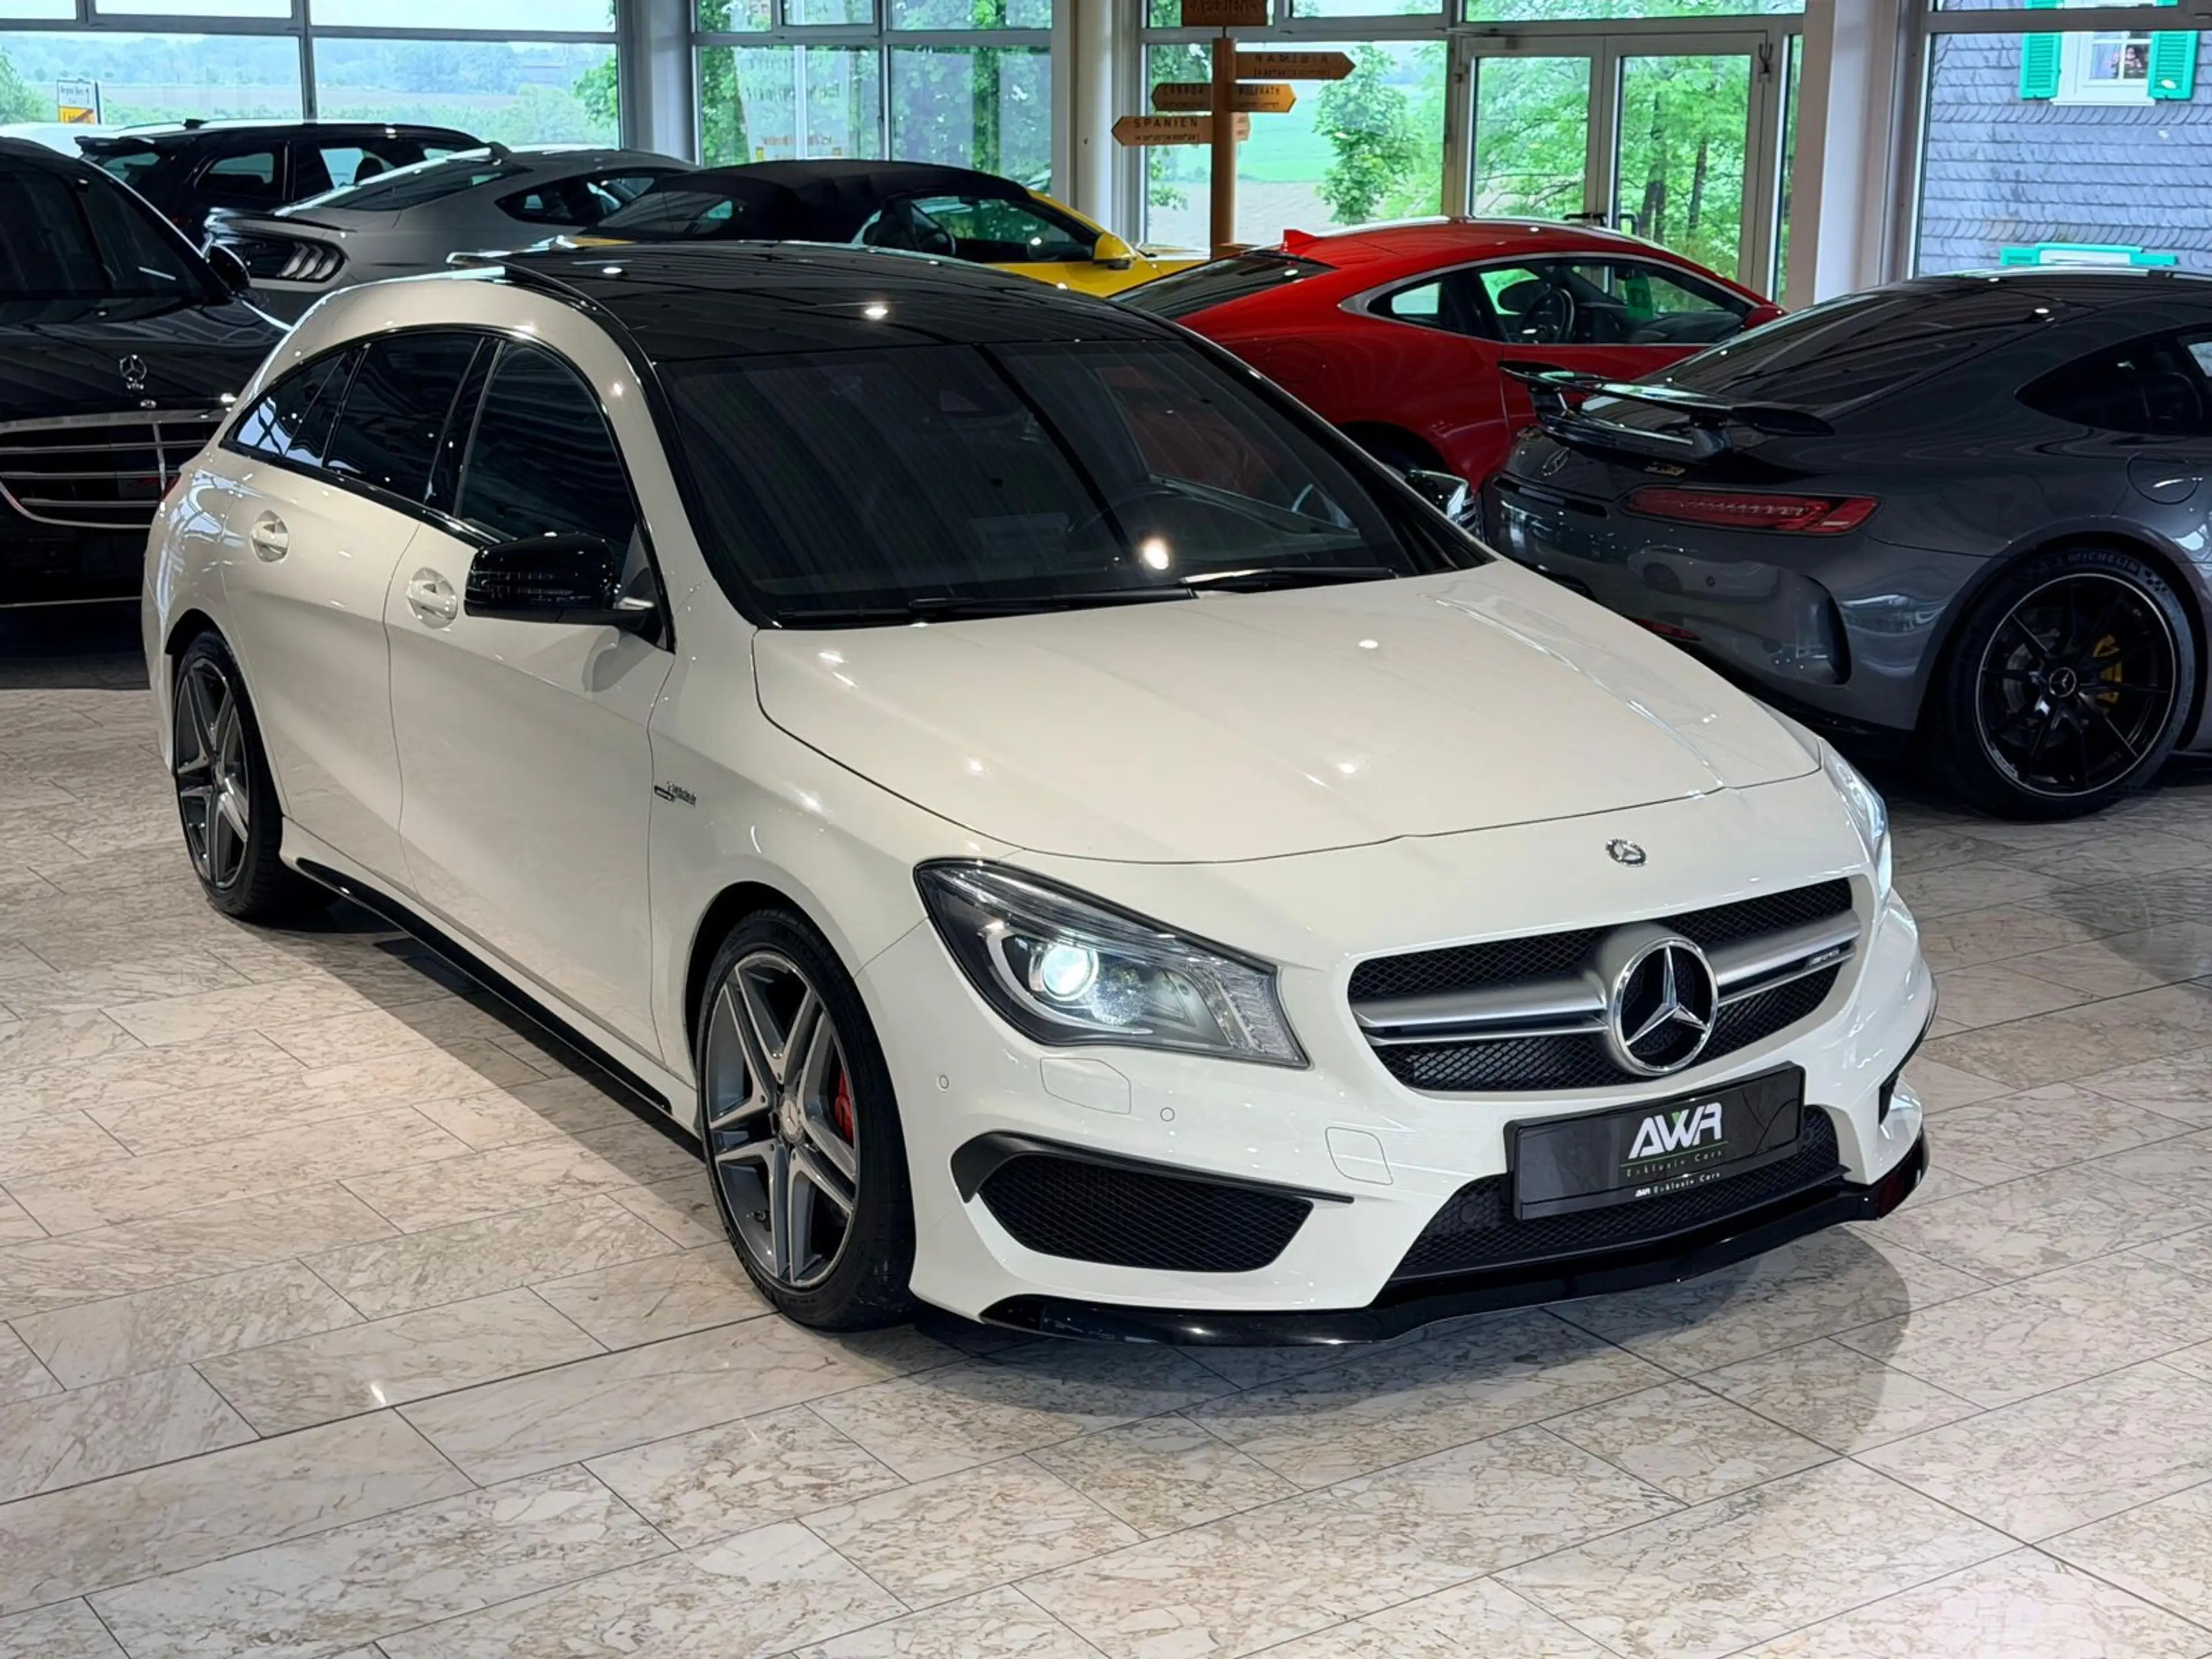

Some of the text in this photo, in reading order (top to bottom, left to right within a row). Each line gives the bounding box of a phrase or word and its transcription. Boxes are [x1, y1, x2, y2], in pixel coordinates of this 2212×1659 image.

[1134, 118, 1198, 128] SPANIEN
[2068, 552, 2139, 572] MICHELIN
[1628, 1101, 1722, 1160] AWR
[1694, 1150, 1722, 1162] Cars
[1699, 1172, 1721, 1183] Cars
